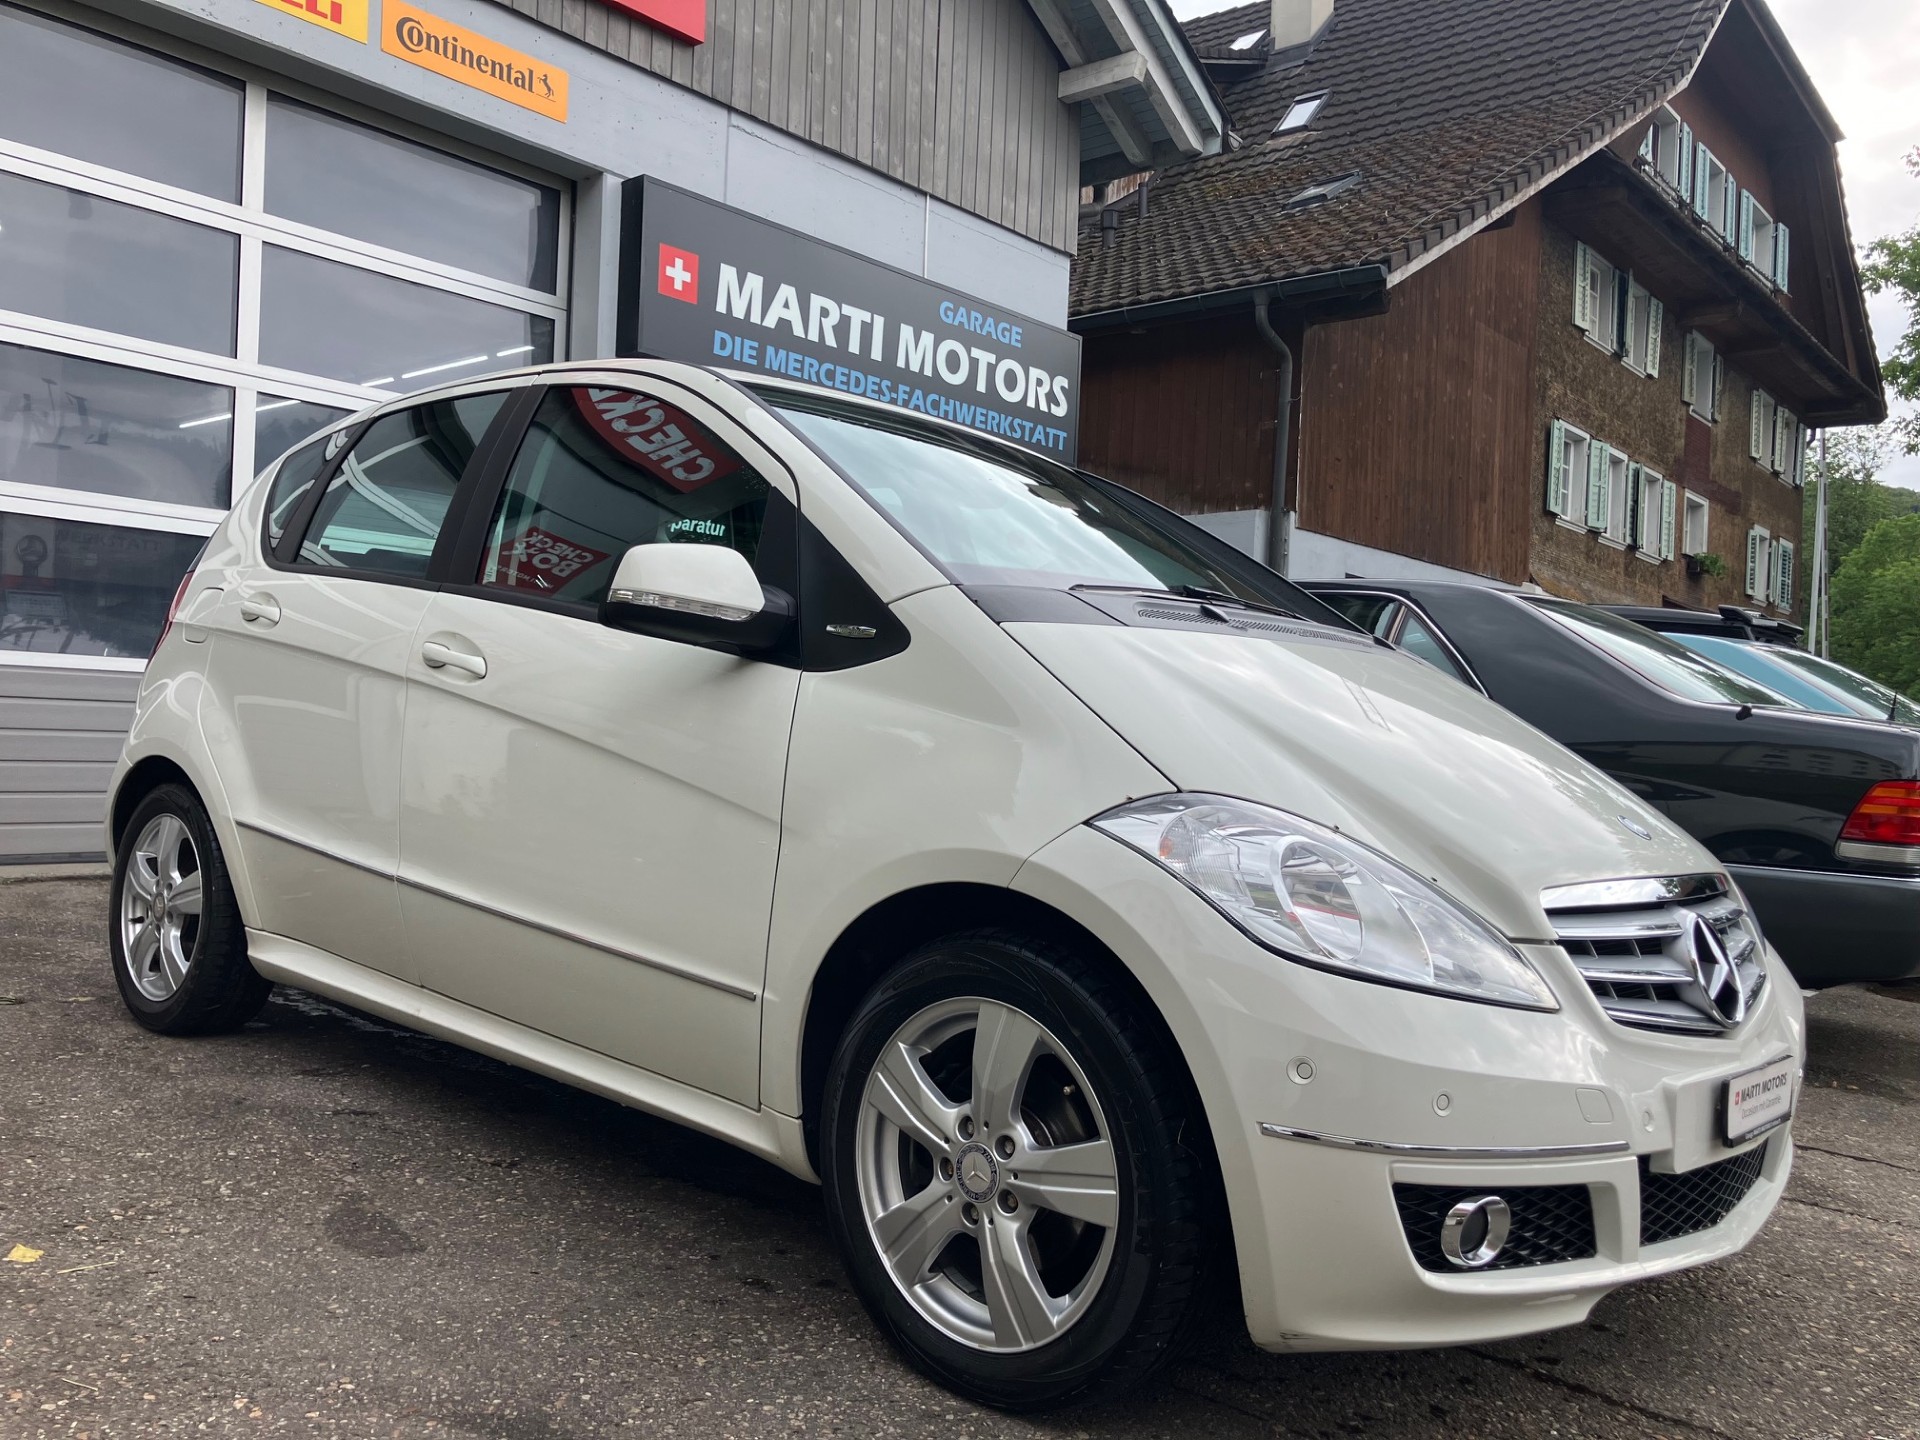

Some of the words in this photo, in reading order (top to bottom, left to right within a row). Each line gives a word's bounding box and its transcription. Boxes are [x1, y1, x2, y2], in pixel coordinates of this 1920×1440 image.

[396, 16, 535, 93] Continental
[715, 262, 885, 362] MARTI
[896, 323, 1069, 417] MOTORS
[939, 301, 1023, 348] GARAGE
[713, 329, 759, 366] DIE
[764, 344, 1067, 450] MERCEDES-FACHWERKSTATT
[1741, 1082, 1761, 1103] MARTI
[1761, 1072, 1787, 1094] MOTORS
